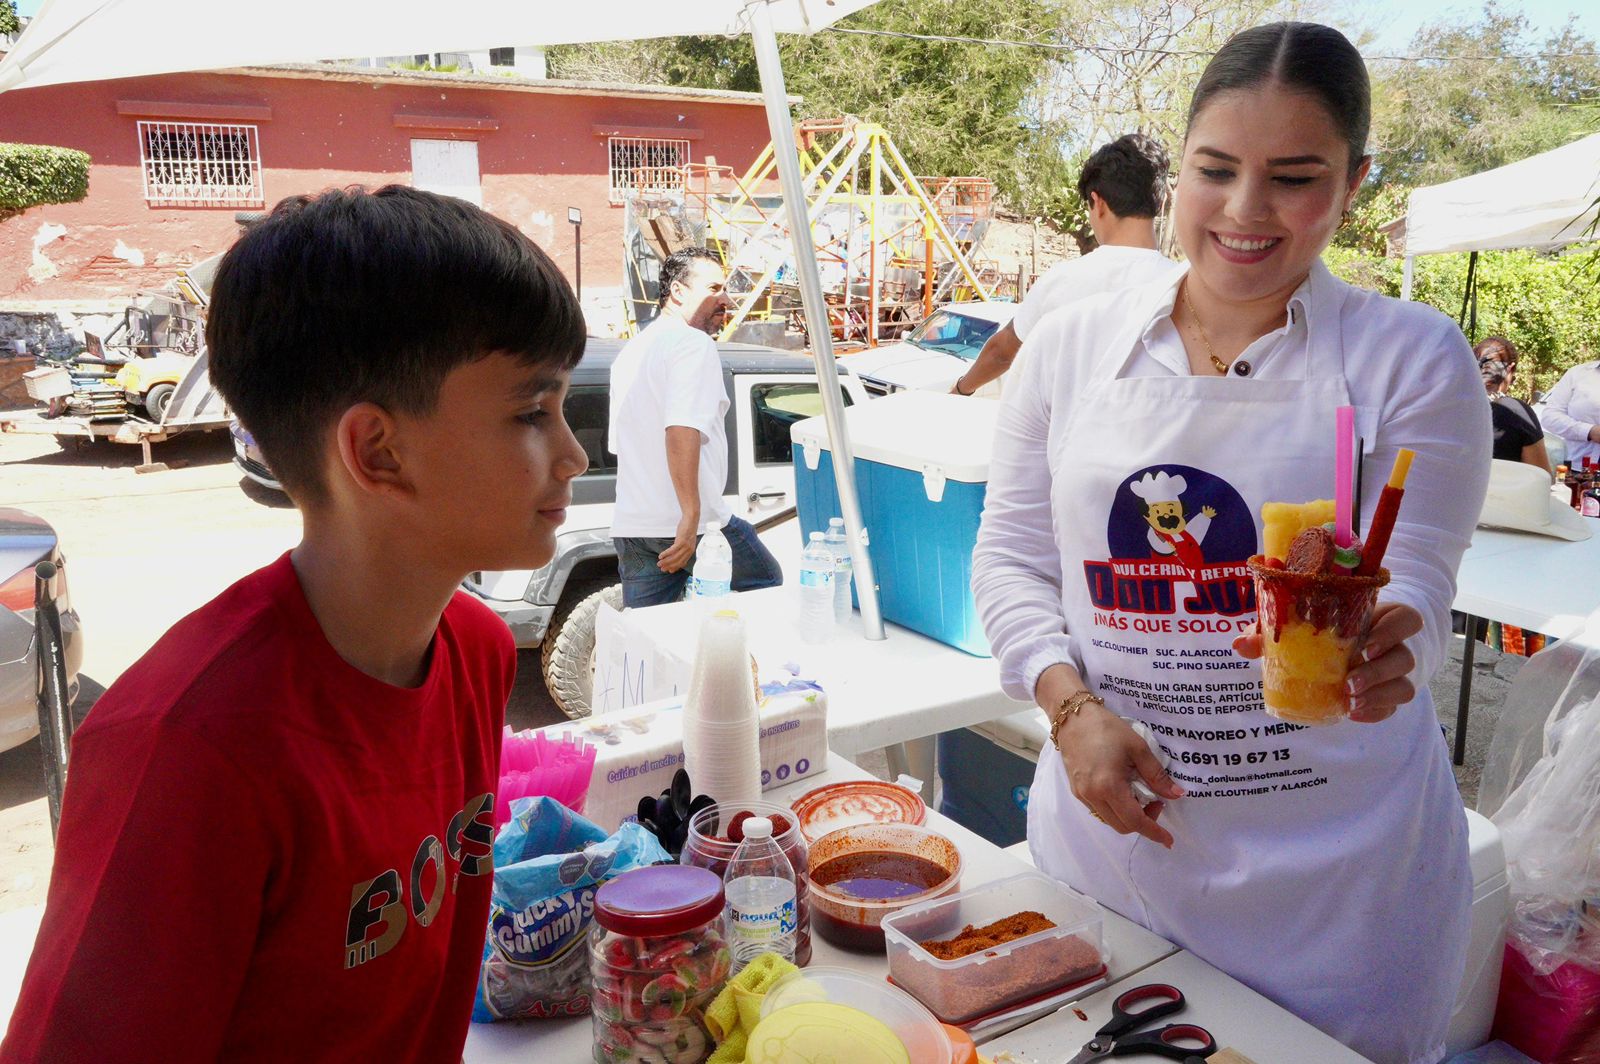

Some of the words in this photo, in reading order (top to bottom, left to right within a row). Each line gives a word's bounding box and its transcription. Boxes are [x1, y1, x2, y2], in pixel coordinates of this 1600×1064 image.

[1112, 563, 1186, 576] DULCERIA
[1185, 567, 1196, 579] Y
[1201, 566, 1256, 581] REPOS
[1094, 612, 1128, 630] ¡MÁS
[1133, 618, 1172, 634] QUE
[1178, 619, 1232, 633] SOLO
[1155, 648, 1178, 657] SUC.
[1179, 648, 1233, 657] ALARCON
[1152, 661, 1175, 670] SUC.
[1176, 662, 1203, 670] PINO
[1205, 661, 1250, 670] SUAREZ
[1103, 673, 1114, 683] TE
[1114, 676, 1152, 691] OFRECEN
[1154, 683, 1170, 692] UN
[1172, 683, 1202, 692] GRAN
[1205, 681, 1255, 692] SURTIDO
[1257, 680, 1264, 689] E
[1099, 682, 1140, 699] ARTÍCULOS
[1141, 691, 1217, 704] DESECHABLES,
[1218, 692, 1265, 703] ARTÍCUL
[1134, 700, 1141, 708] Y
[1142, 701, 1195, 715] ARTÍCULOS
[1197, 706, 1212, 715] DE
[1215, 702, 1266, 715] REPOSTE
[767, 719, 801, 737] nosotros
[1150, 722, 1175, 737] POR
[1176, 727, 1247, 741] MAYOREO
[1249, 726, 1260, 738] Y
[1181, 751, 1219, 766] 6691
[1223, 753, 1242, 766] 19
[1246, 751, 1268, 764] 67
[1272, 748, 1291, 761] 13
[608, 766, 638, 783] Cuidar
[639, 760, 650, 774] el
[650, 753, 678, 771] medio
[1186, 790, 1212, 798] JUAN
[1214, 786, 1270, 798] CLOUTHIER
[1280, 776, 1328, 791] ALARCÓN
